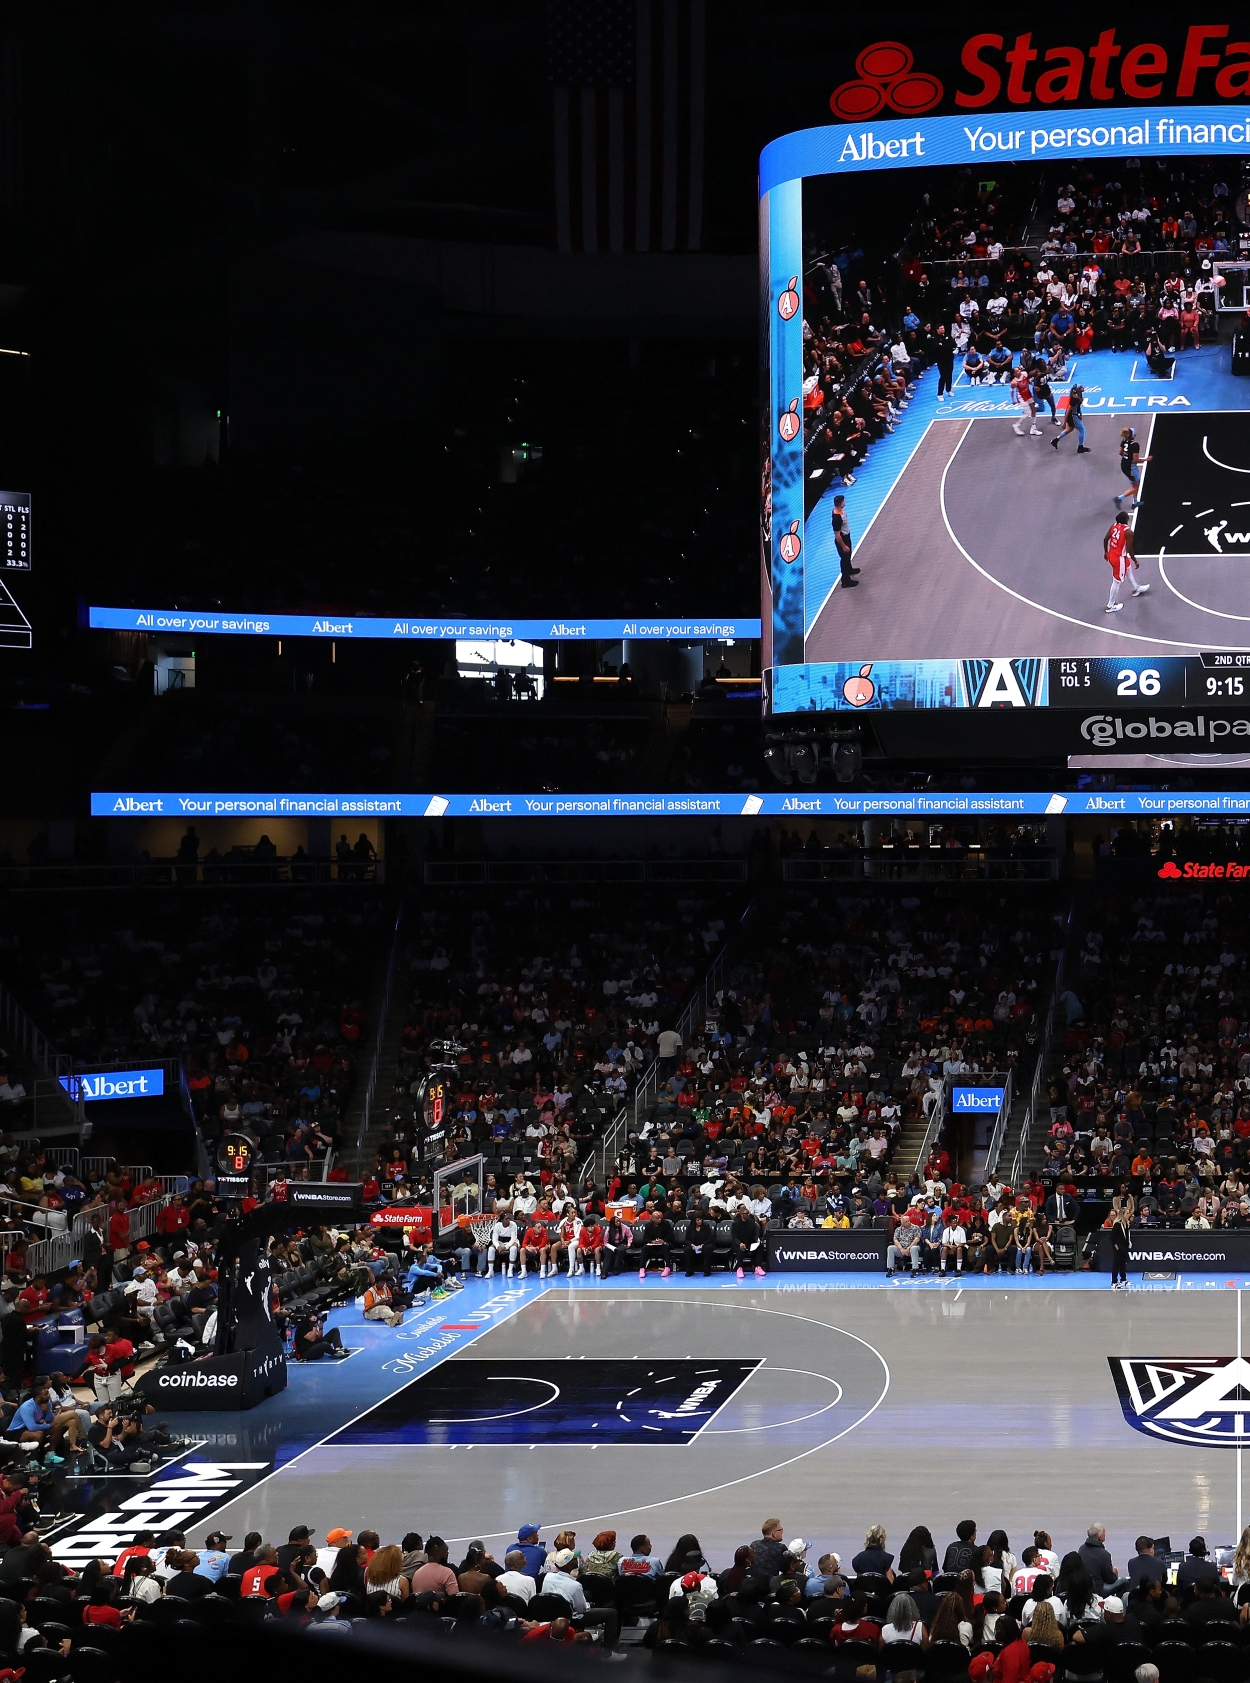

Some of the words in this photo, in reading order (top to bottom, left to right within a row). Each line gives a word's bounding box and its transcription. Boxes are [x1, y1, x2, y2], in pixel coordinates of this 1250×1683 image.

[963, 126, 1030, 152] Your
[1031, 119, 1150, 155] personal
[839, 132, 926, 162] Albert
[1083, 395, 1191, 408] ULTRA
[4, 505, 15, 513] STL
[6, 560, 28, 568] 33.3%
[136, 614, 154, 626] All
[156, 617, 187, 627] over
[189, 619, 220, 631] your
[221, 618, 270, 633] savings
[312, 620, 353, 633] Albert
[393, 623, 409, 634] All
[411, 626, 438, 635] over
[439, 626, 467, 638] your
[469, 625, 513, 637] savings
[549, 624, 586, 635] Albert
[622, 624, 637, 634] All
[639, 626, 666, 635] over
[666, 626, 692, 637] your
[693, 624, 735, 637] savings
[1060, 662, 1077, 673] FLS
[1084, 662, 1090, 673] 1
[1214, 655, 1234, 665] 2ND
[1060, 675, 1081, 687] TOL
[1084, 675, 1091, 687] 5
[1116, 668, 1161, 696] 26
[1206, 676, 1244, 696] 9:15
[113, 797, 164, 811] Albert
[178, 798, 213, 811] Your
[215, 798, 278, 814] personal
[279, 798, 338, 811] financial
[341, 799, 402, 811] assistant
[469, 798, 512, 812] Albert
[525, 799, 554, 811] Your
[556, 798, 611, 814] personal
[612, 798, 665, 811] financial
[667, 799, 721, 811] assistant
[781, 797, 822, 810] Albert
[833, 798, 861, 810] Your
[863, 797, 915, 811] personal
[917, 797, 968, 810] financial
[970, 797, 1025, 810] assistant
[1086, 796, 1126, 809] Albert
[1138, 797, 1166, 810] Your
[1167, 797, 1220, 812] personal
[79, 1075, 148, 1098] Albert
[956, 1092, 1000, 1107] Albert
[227, 1145, 248, 1156] 9:15
[235, 1156, 244, 1170] 8
[782, 1249, 879, 1261] WNBAStore.com
[1128, 1250, 1226, 1262] WNBAStore.com
[459, 1287, 532, 1322] ULTRA
[158, 1370, 239, 1388] coinbase
[675, 1379, 723, 1412] WNBA
[251, 1576, 262, 1592] 5
